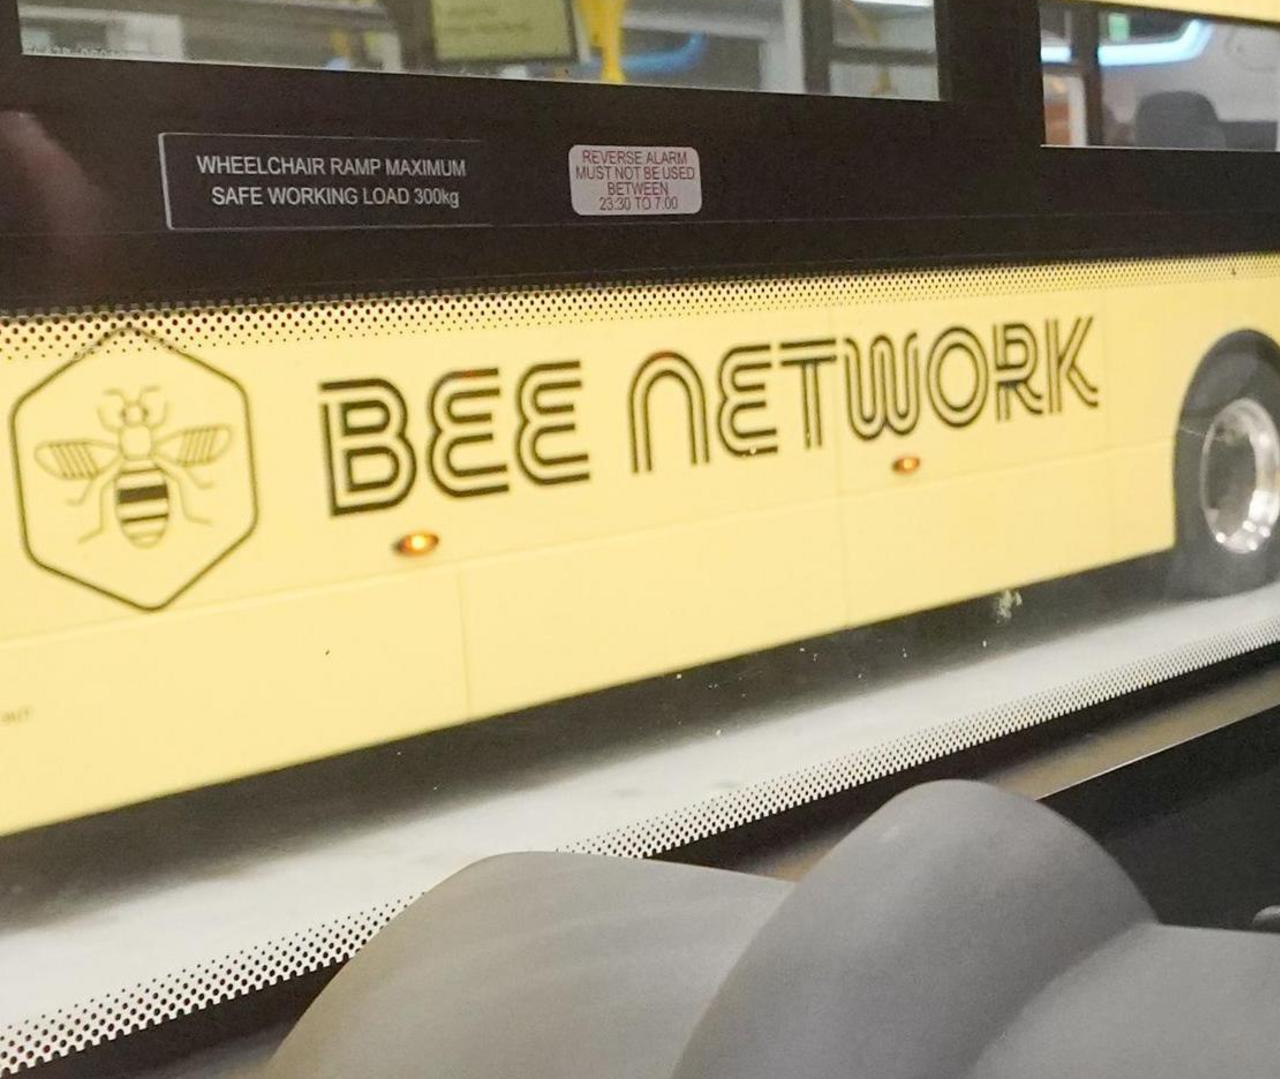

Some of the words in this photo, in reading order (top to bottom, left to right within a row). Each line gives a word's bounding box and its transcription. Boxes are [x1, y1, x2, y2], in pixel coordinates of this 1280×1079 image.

[582, 150, 641, 165] REVERSE
[646, 151, 688, 165] ALARM
[197, 156, 326, 176] WHEELCHAIR
[330, 157, 381, 176] RAMP
[385, 159, 467, 177] MAXIMUM
[576, 166, 611, 180] MUST
[615, 166, 641, 180] NOT
[643, 166, 660, 180] BE
[662, 166, 695, 180] USED
[607, 181, 669, 196] BETWEEN
[211, 187, 263, 206] SAFE
[267, 187, 358, 206] WORKING
[363, 187, 409, 205] LOAD
[414, 188, 460, 209] 300kg
[636, 196, 652, 210] TO
[320, 360, 590, 518] BEE
[629, 315, 1099, 473] NETWORK
